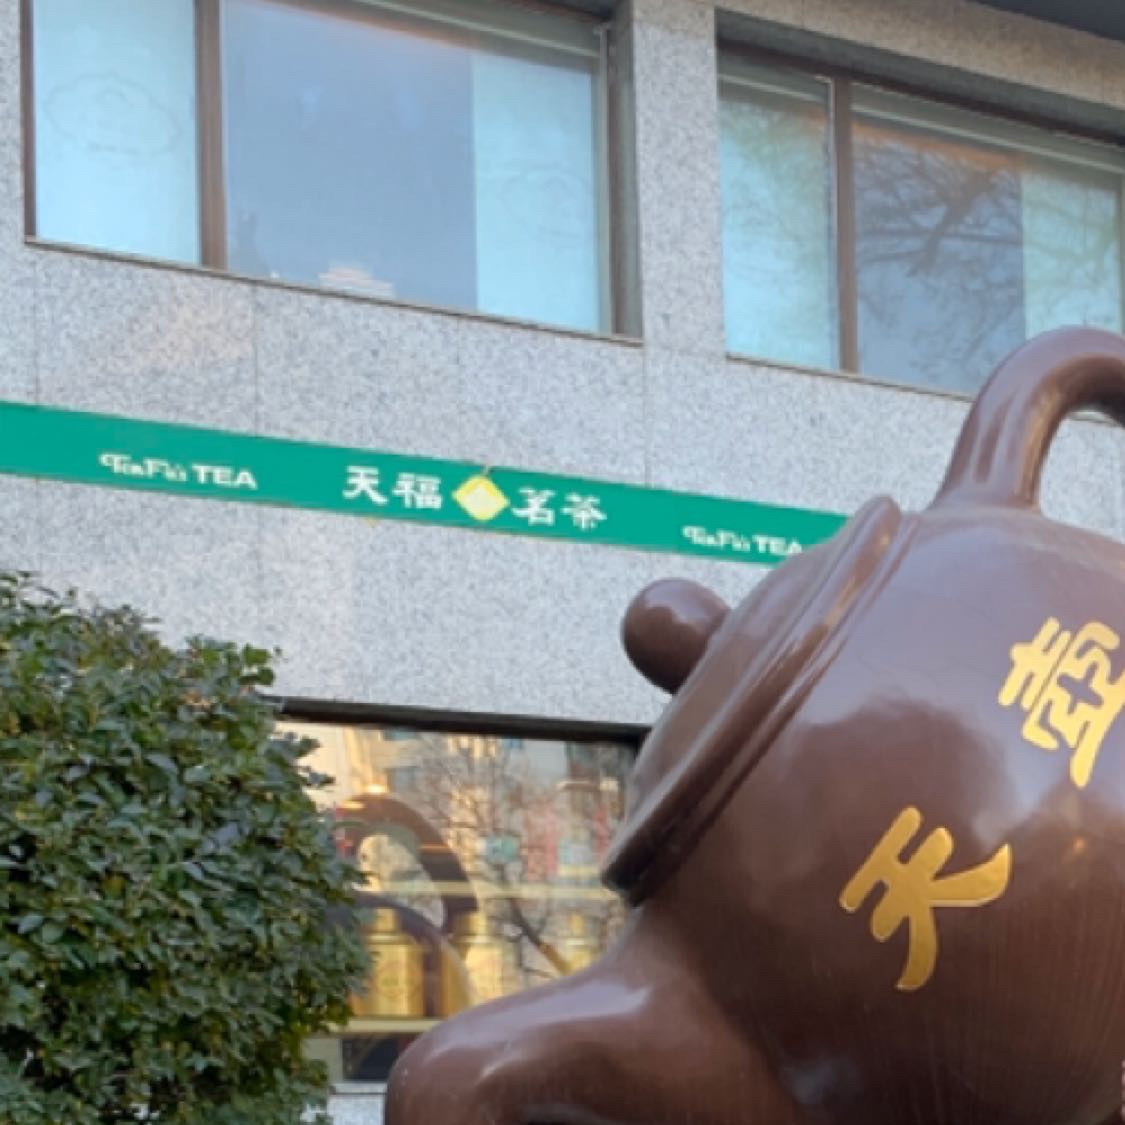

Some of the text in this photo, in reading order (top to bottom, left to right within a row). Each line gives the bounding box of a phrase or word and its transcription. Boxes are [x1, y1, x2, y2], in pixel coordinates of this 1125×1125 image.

[192, 463, 258, 490] TEA
[342, 465, 607, 529] 天福 茗茶
